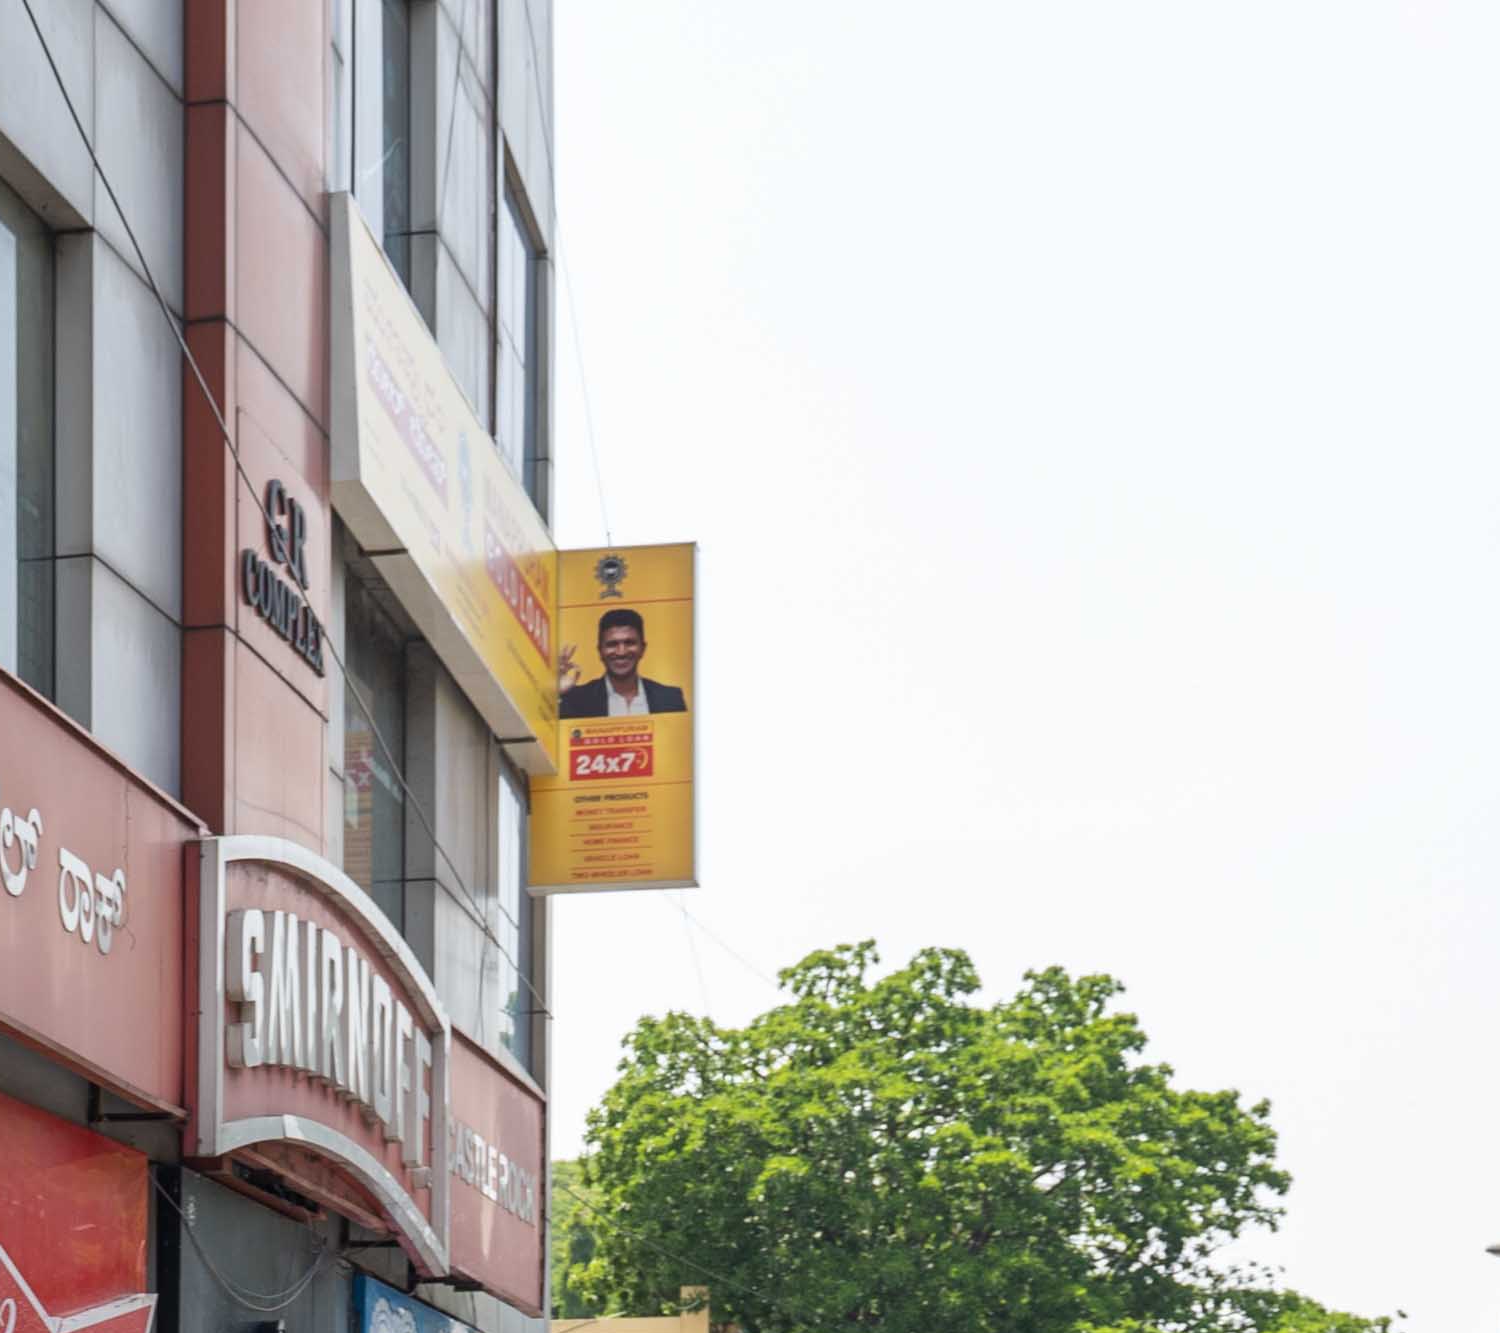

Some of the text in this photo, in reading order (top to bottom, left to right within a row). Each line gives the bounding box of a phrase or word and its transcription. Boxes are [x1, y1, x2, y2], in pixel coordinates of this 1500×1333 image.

[240, 547, 325, 678] COMPLEX
[575, 752, 636, 775] 24x7
[59, 847, 126, 954] ರಾಕ್
[242, 909, 433, 1166] SMIRNOFF
